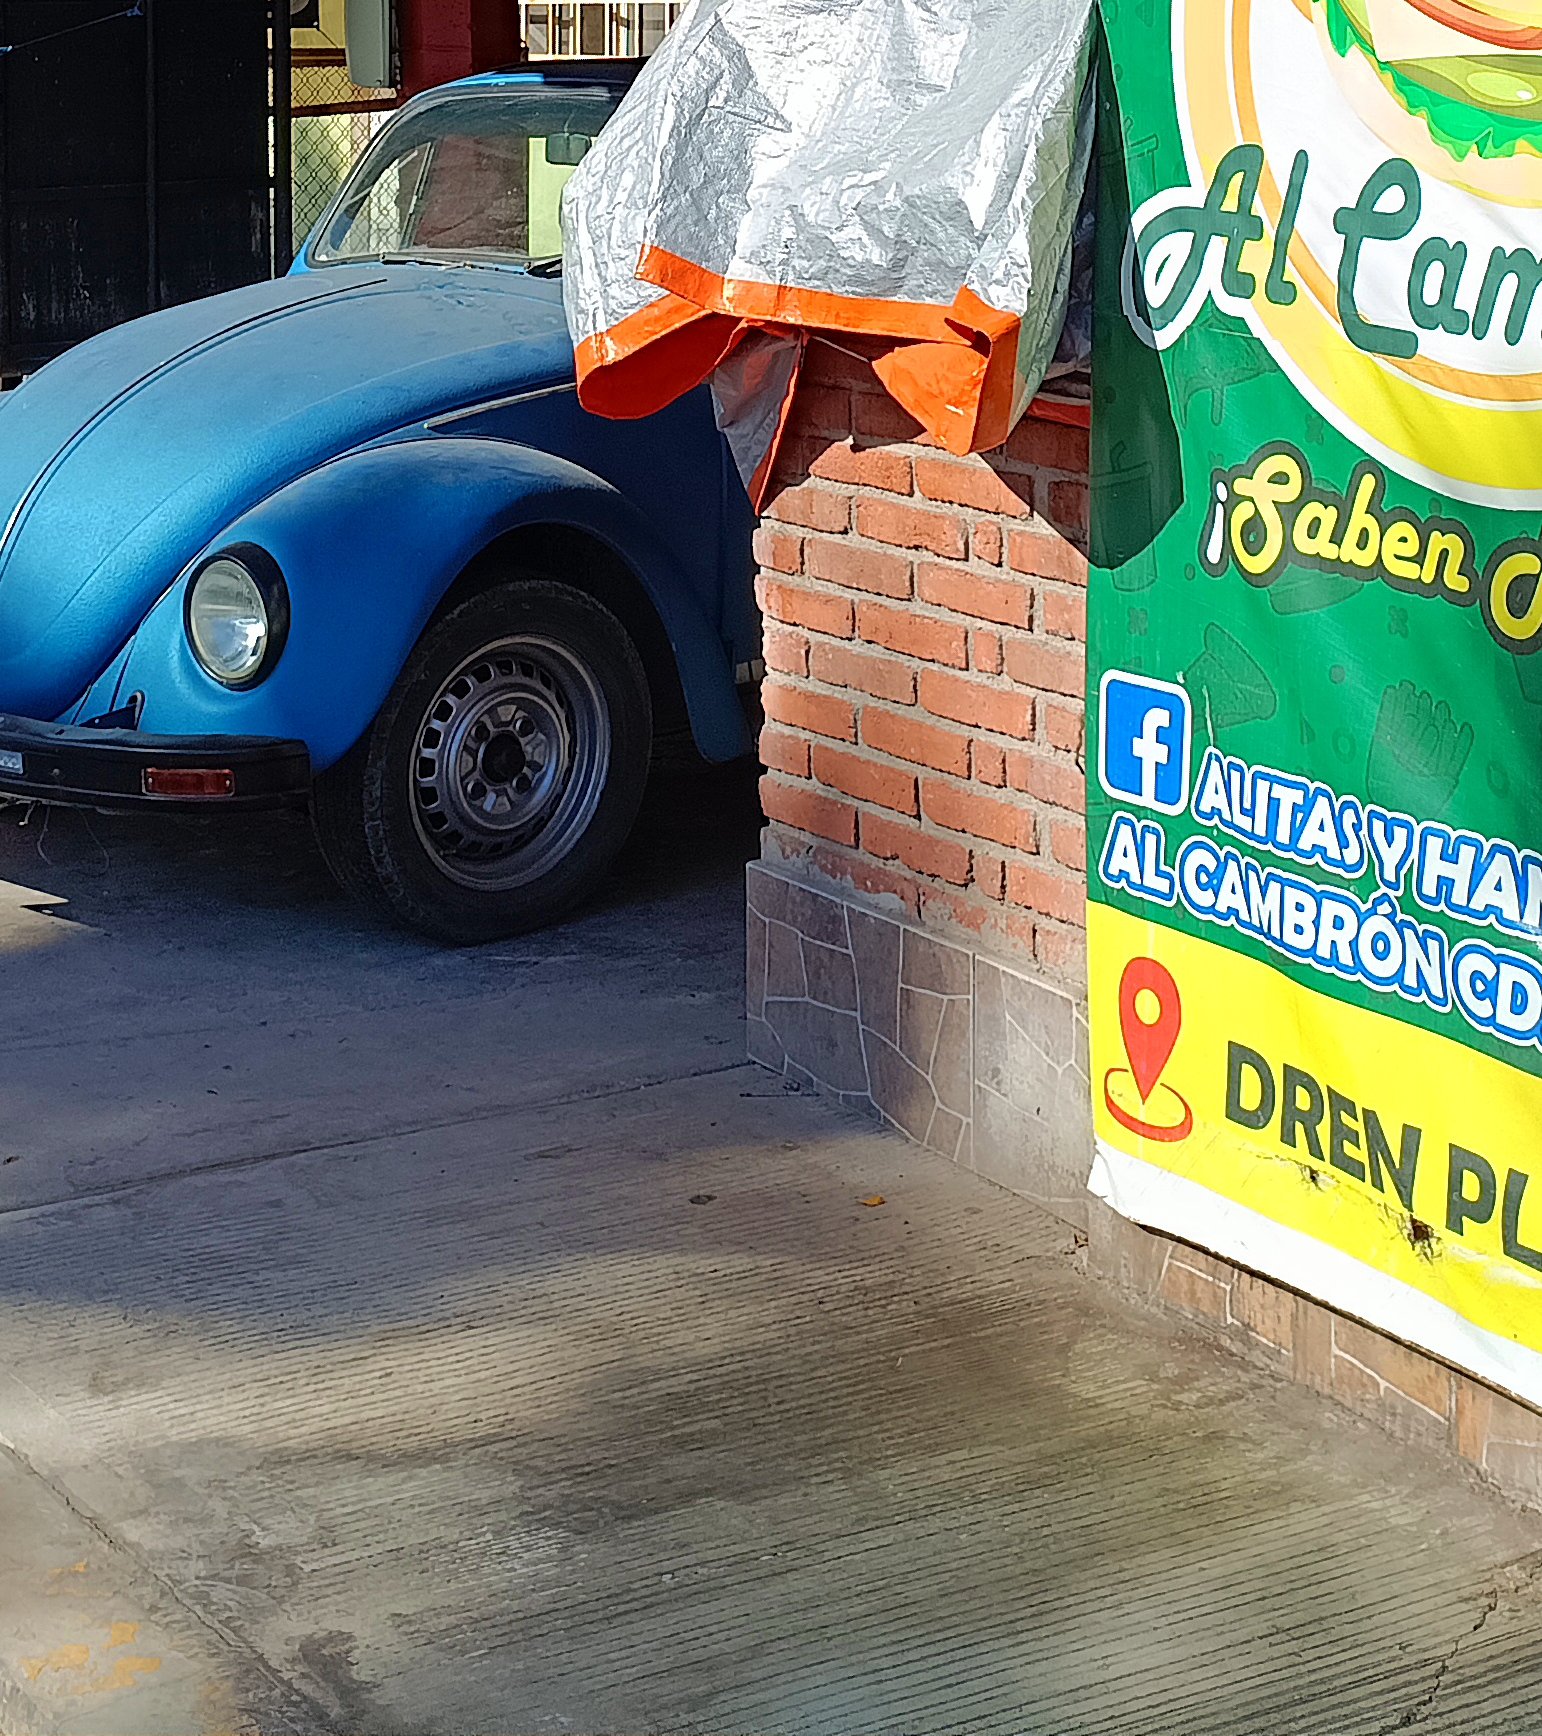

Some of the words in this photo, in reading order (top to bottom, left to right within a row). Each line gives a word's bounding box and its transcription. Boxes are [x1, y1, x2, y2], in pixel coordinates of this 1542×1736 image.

[1136, 141, 1308, 328] Al
[1206, 454, 1472, 592] ¡Saben
[1199, 752, 1363, 866] ALITAS
[1370, 810, 1416, 886] Y
[1104, 822, 1175, 894] AL
[1182, 838, 1447, 1002] CAMBRÓN
[1224, 1043, 1423, 1212] DREN
